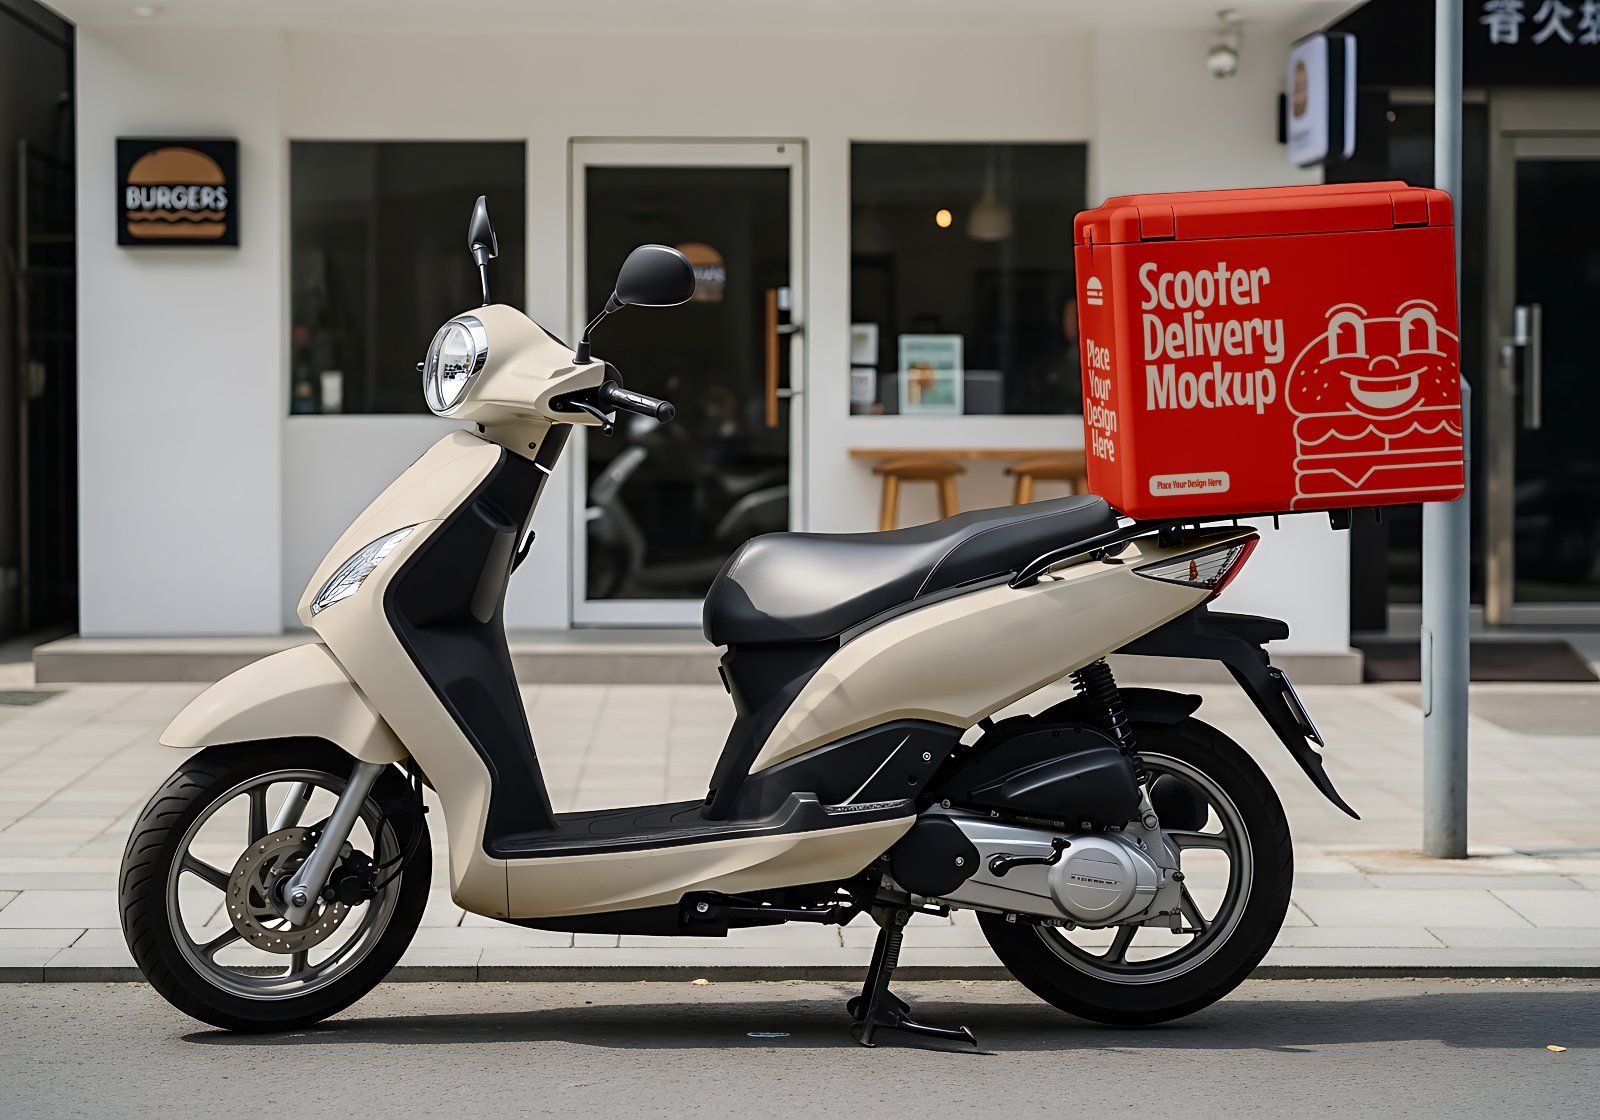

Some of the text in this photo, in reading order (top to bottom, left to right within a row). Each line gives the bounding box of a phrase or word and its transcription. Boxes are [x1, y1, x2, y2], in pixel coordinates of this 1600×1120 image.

[126, 185, 228, 210] BURGERS
[1138, 262, 1271, 310] Scooter
[1142, 310, 1285, 364] Delivery
[1087, 338, 1111, 371] Place
[1088, 369, 1111, 400] Your
[1145, 362, 1277, 415] Mockup
[1086, 398, 1118, 437] Design
[1091, 429, 1115, 462] Here
[1157, 478, 1222, 490] Place Your Design Here
